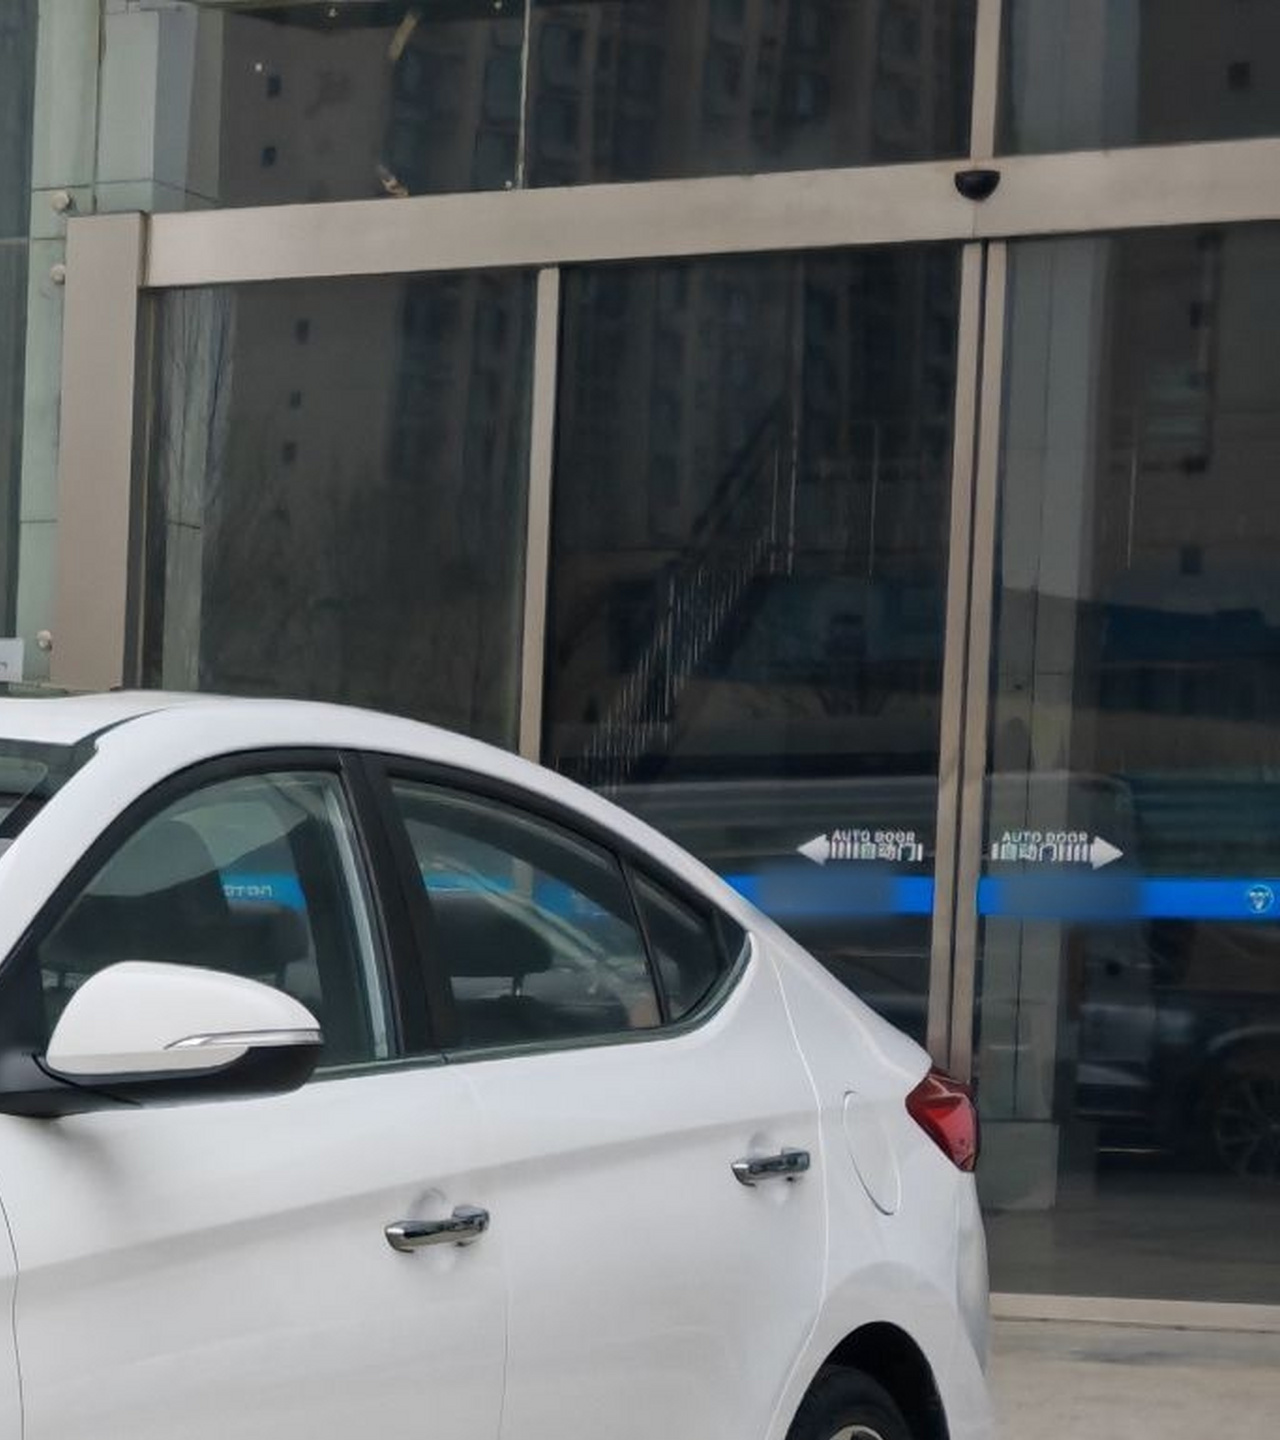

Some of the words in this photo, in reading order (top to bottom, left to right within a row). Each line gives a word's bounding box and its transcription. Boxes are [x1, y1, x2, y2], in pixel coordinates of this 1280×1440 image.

[831, 828, 871, 843] AUTO
[874, 830, 916, 844] DOOR
[1002, 831, 1042, 844] AUTO
[1046, 831, 1089, 843] DOOR
[860, 842, 917, 861] 自动门
[1000, 842, 1058, 861] 自动门
